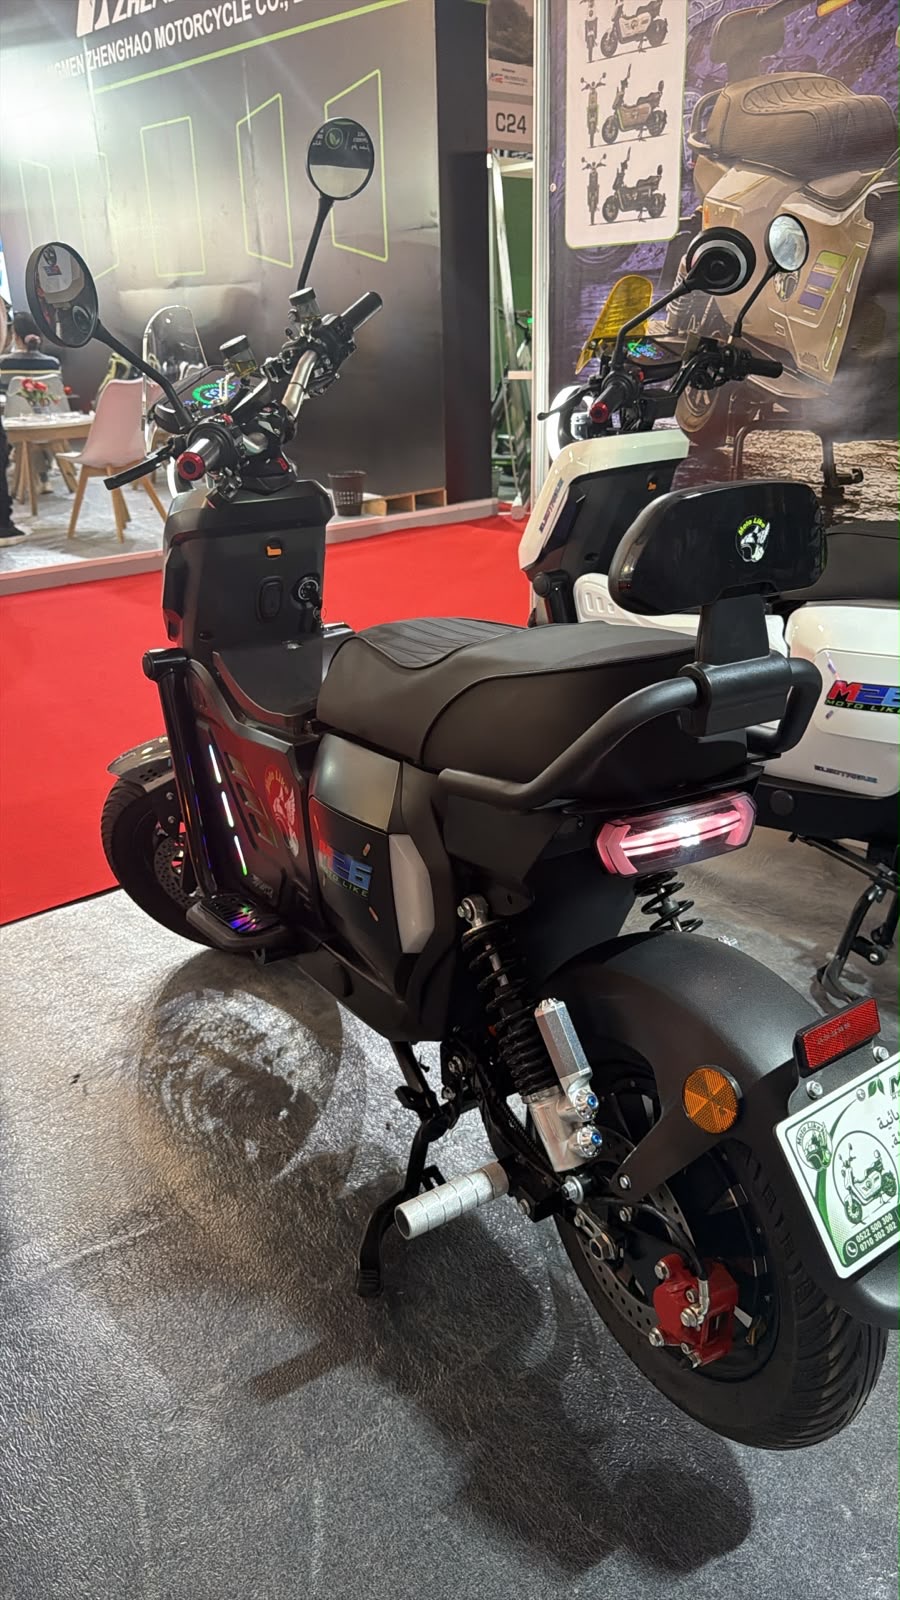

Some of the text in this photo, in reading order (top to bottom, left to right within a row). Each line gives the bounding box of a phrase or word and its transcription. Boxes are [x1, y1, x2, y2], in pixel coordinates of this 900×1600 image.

[86, 31, 152, 71] ZHENGHAO
[154, 0, 252, 49] MOTORCYCLE
[495, 112, 527, 134] C24
[826, 699, 864, 710] MOTO
[856, 1212, 893, 1243] 0522 500 300
[860, 1221, 897, 1251] 0710 302 302
